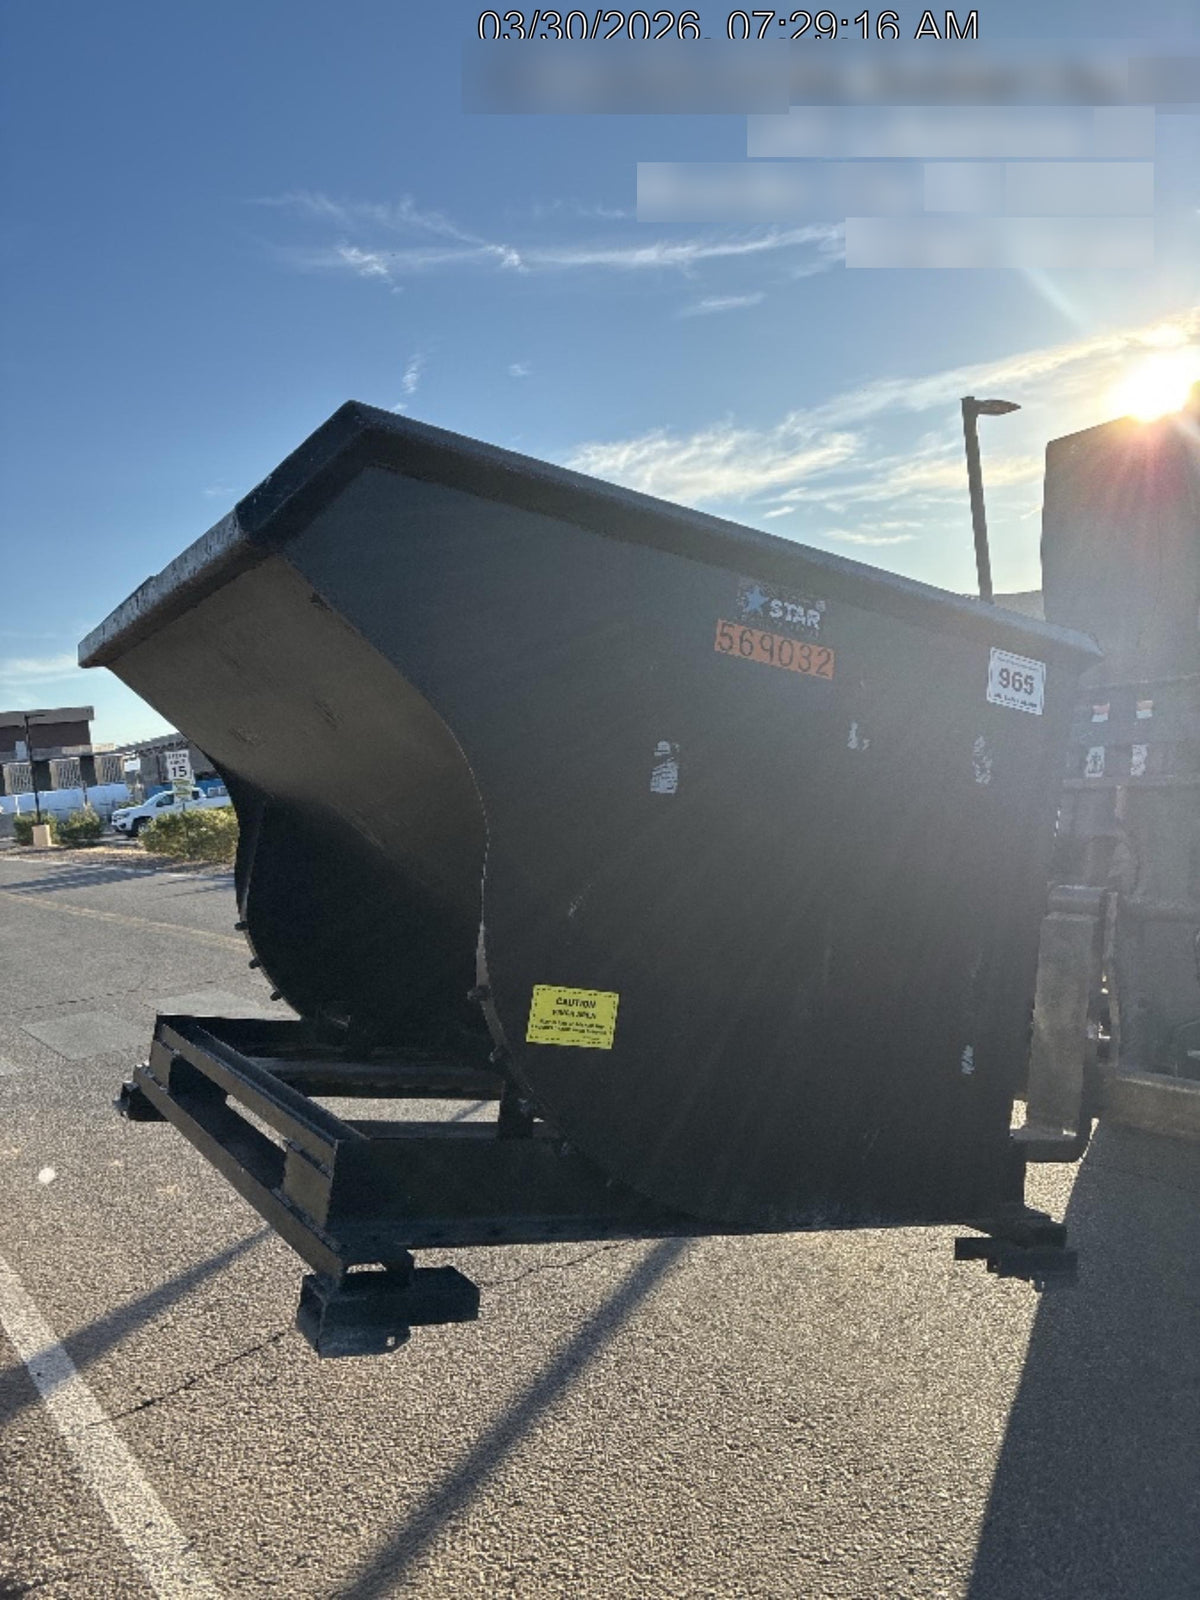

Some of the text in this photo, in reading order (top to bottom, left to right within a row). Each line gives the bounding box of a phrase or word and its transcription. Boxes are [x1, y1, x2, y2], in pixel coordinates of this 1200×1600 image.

[769, 599, 821, 630] STAR
[717, 623, 832, 677] 569032
[172, 766, 187, 777] 15
[556, 996, 596, 1008] CAUTION
